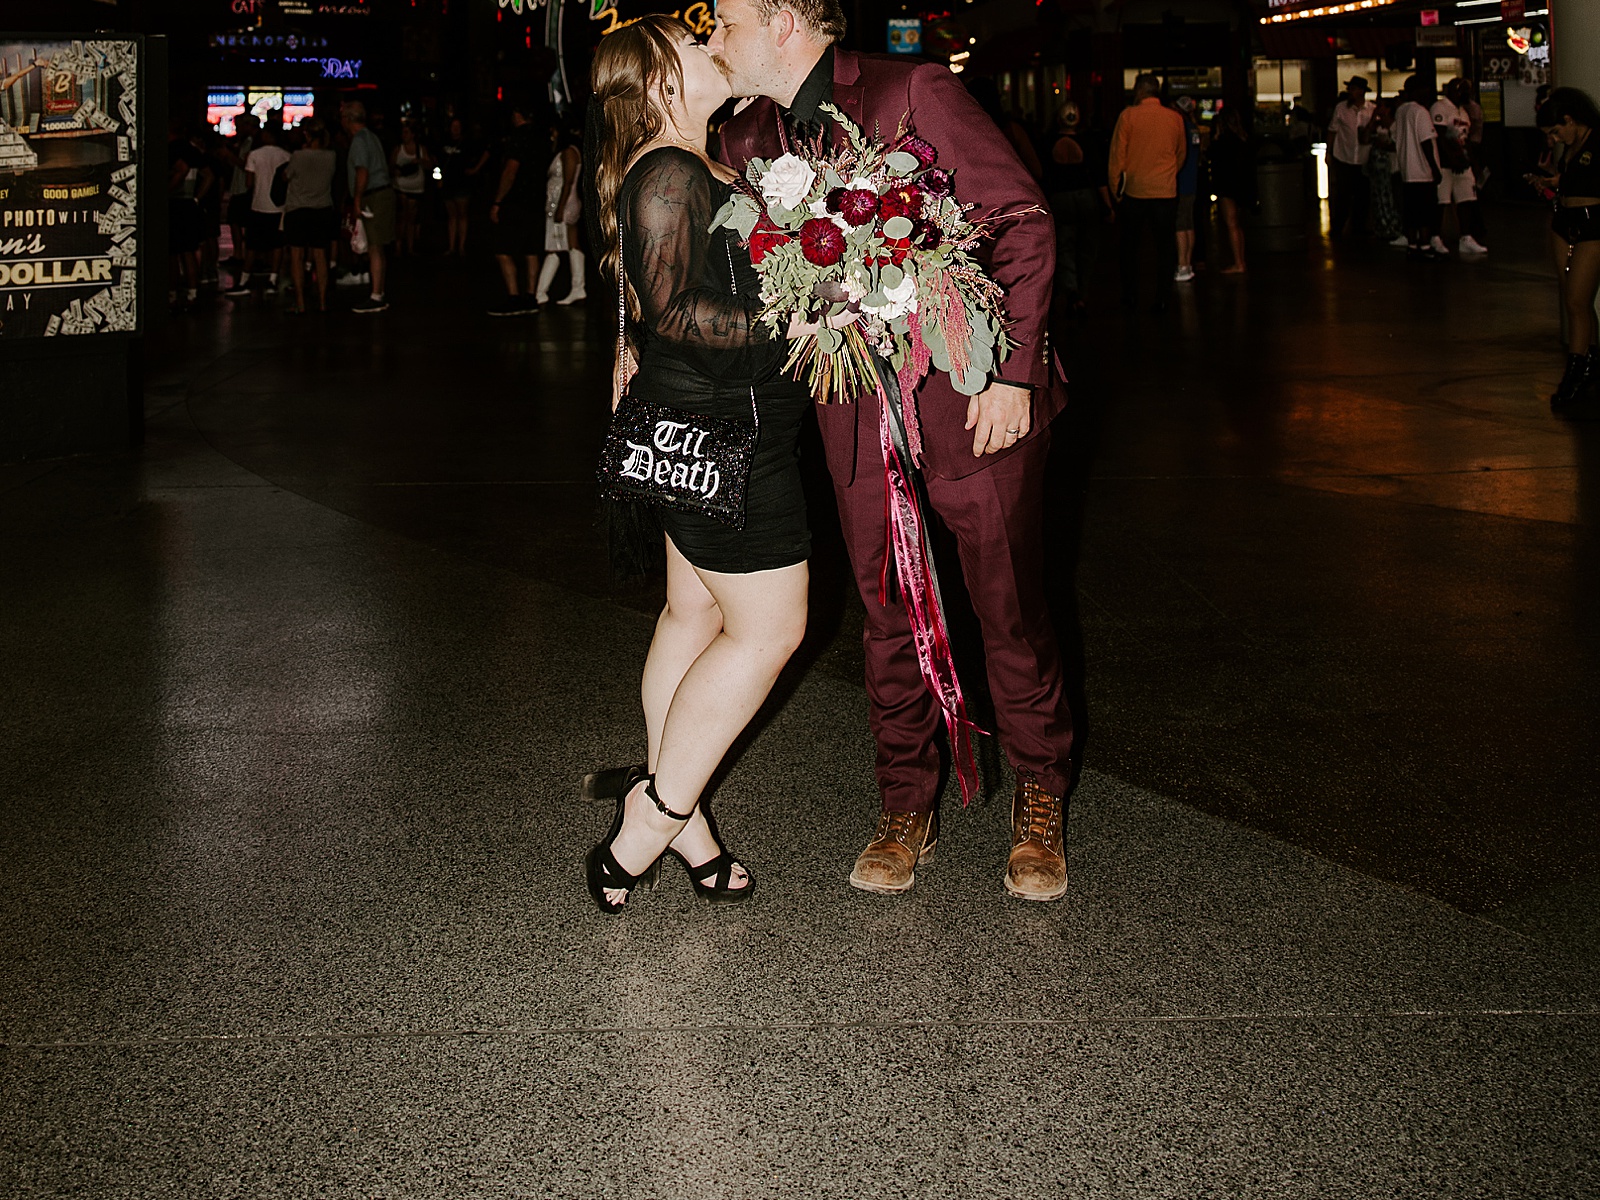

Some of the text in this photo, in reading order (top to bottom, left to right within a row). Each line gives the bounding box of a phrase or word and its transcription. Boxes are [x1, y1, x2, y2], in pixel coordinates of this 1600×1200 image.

[43, 184, 100, 199] GOOD GAMBLE
[4, 209, 100, 228] PHOTO WITH
[0, 259, 112, 286] DOLLAR
[653, 420, 710, 458] Til
[619, 440, 720, 499] Death
